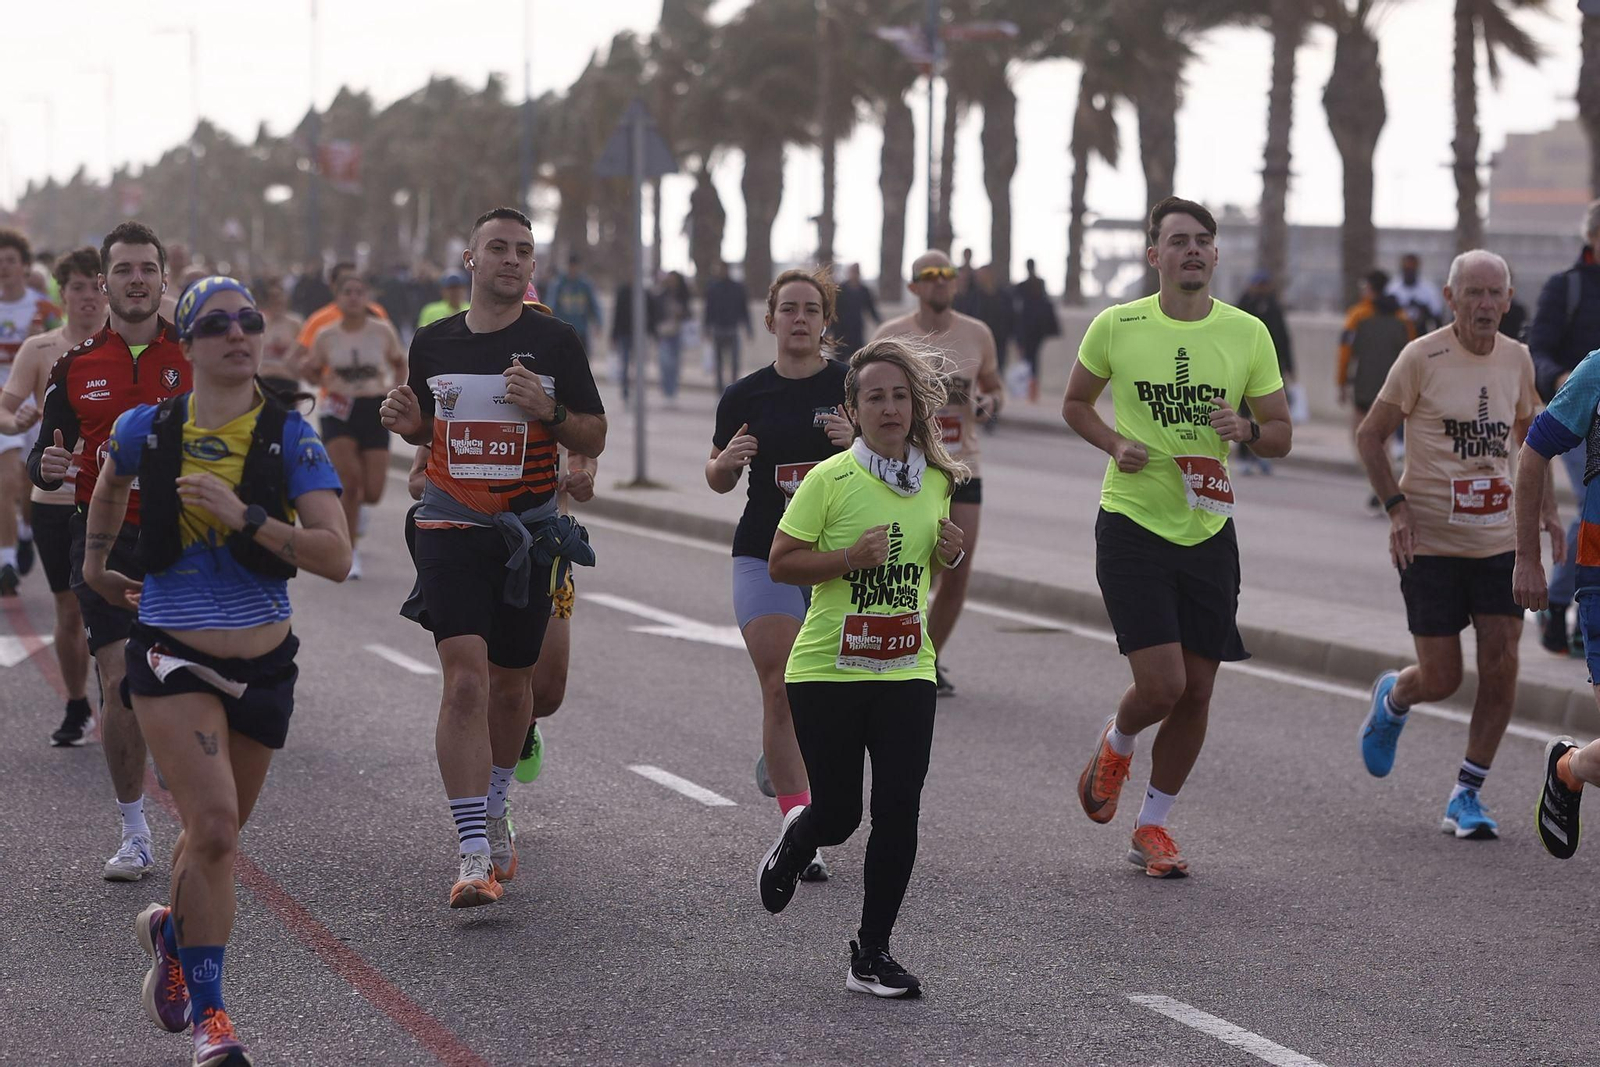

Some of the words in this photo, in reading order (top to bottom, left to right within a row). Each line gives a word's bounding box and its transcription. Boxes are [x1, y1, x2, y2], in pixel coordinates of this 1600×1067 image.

[85, 379, 107, 389] JAKO
[1133, 381, 1226, 406] BRUNCH
[1148, 401, 1194, 428] RUN
[450, 438, 483, 449] BRUNCH
[454, 446, 469, 456] RUN
[488, 441, 516, 456] 291
[1452, 436, 1489, 460] RUN
[1206, 476, 1230, 493] 240
[850, 582, 896, 614] RUN
[892, 595, 918, 611] 2025
[845, 633, 882, 645] BRUNCH
[887, 634, 915, 651] 210
